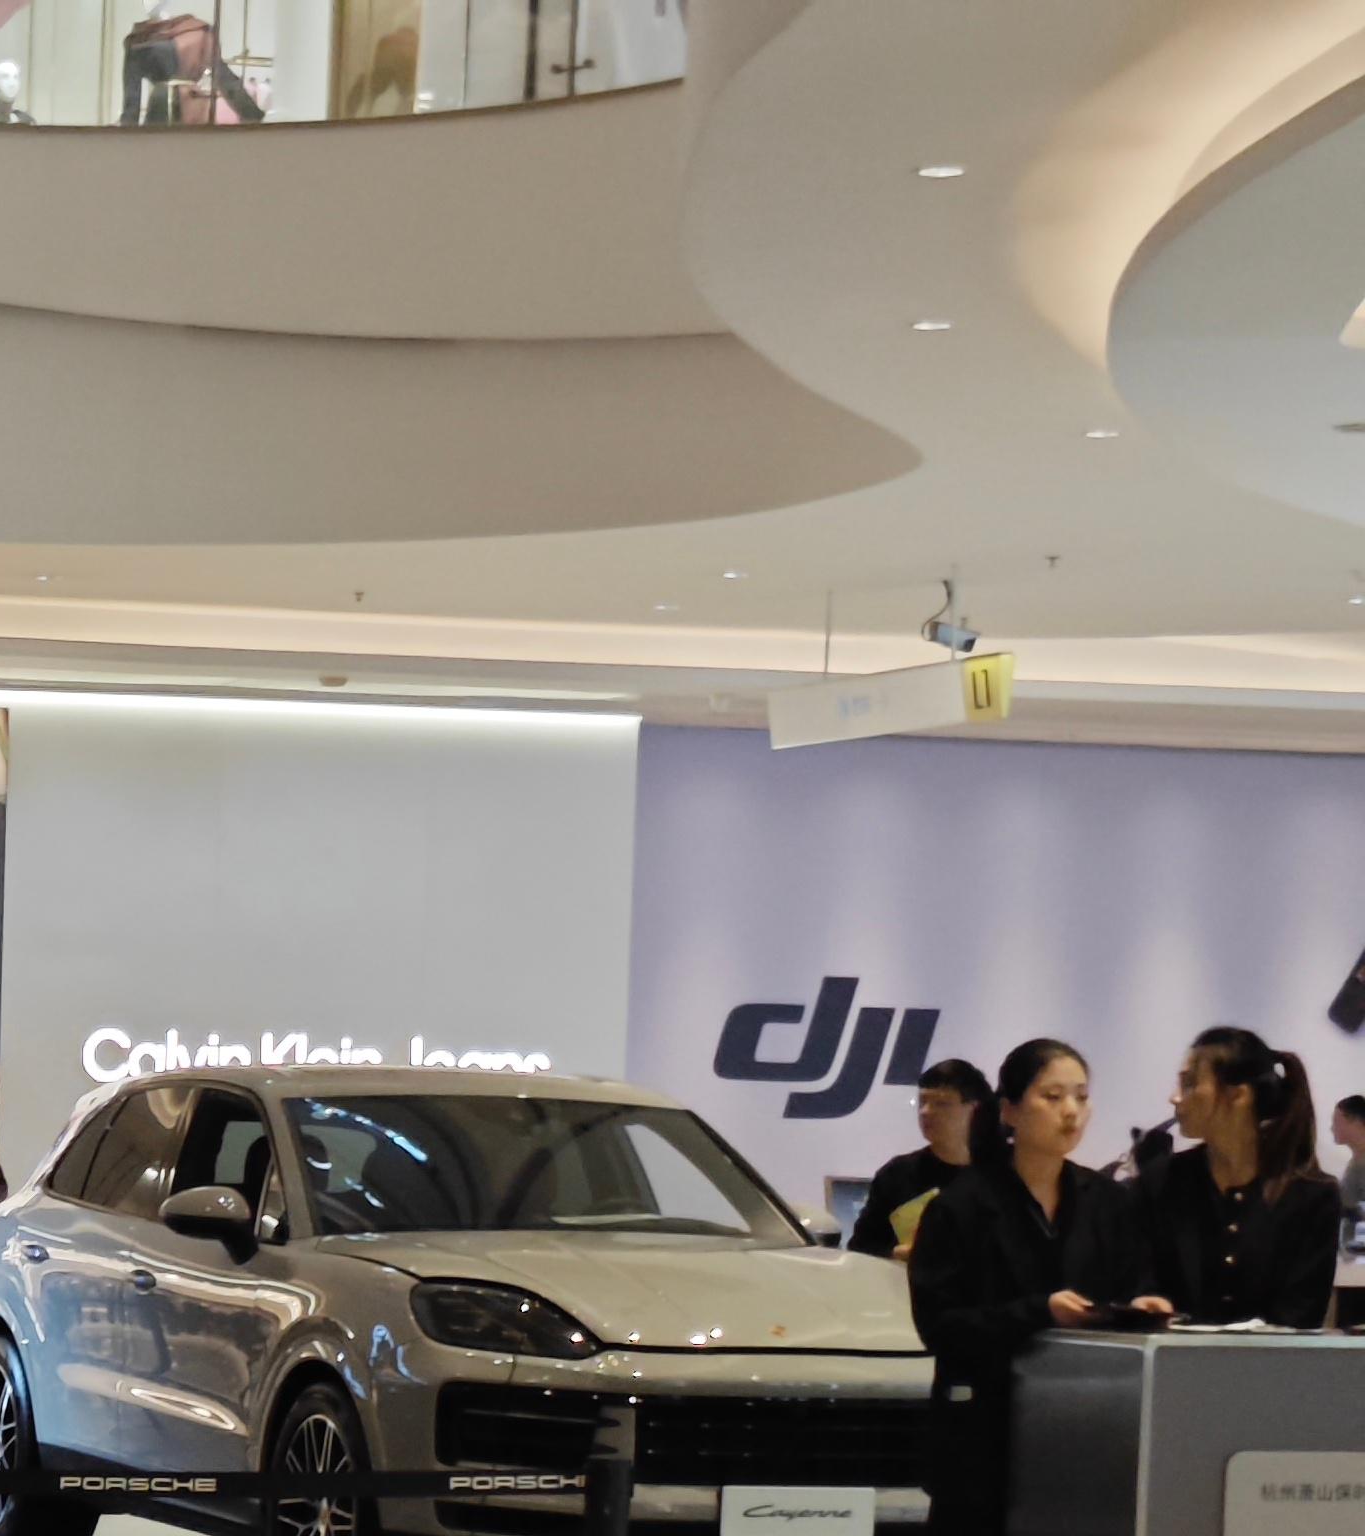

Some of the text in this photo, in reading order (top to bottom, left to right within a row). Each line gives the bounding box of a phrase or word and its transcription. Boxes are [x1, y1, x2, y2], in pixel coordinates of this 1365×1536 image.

[59, 1476, 217, 1492] PORSCHE
[449, 1474, 586, 1491] PORSCH
[742, 1503, 852, 1520] Cayenne
